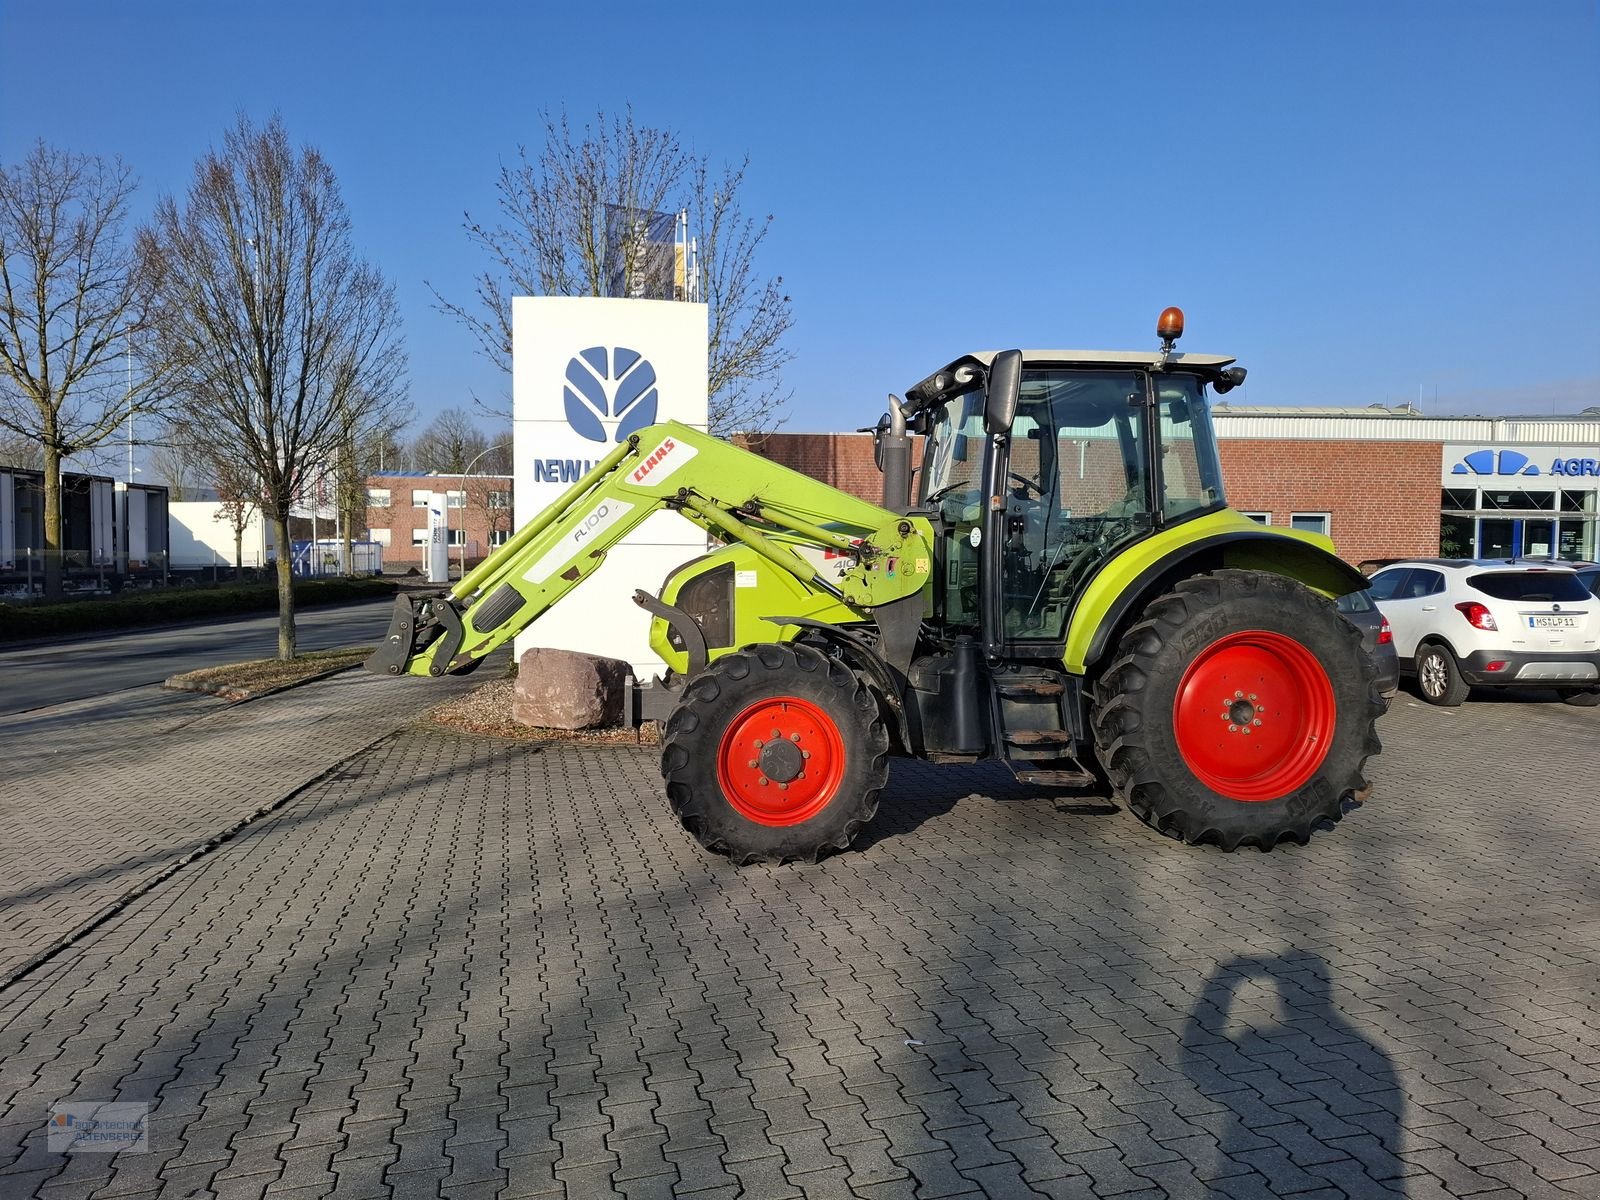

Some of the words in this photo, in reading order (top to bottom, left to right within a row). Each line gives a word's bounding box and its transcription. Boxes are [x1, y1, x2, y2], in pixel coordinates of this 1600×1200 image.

[534, 459, 581, 482] NEW
[633, 439, 675, 482] CLAAS
[833, 559, 856, 569] 410
